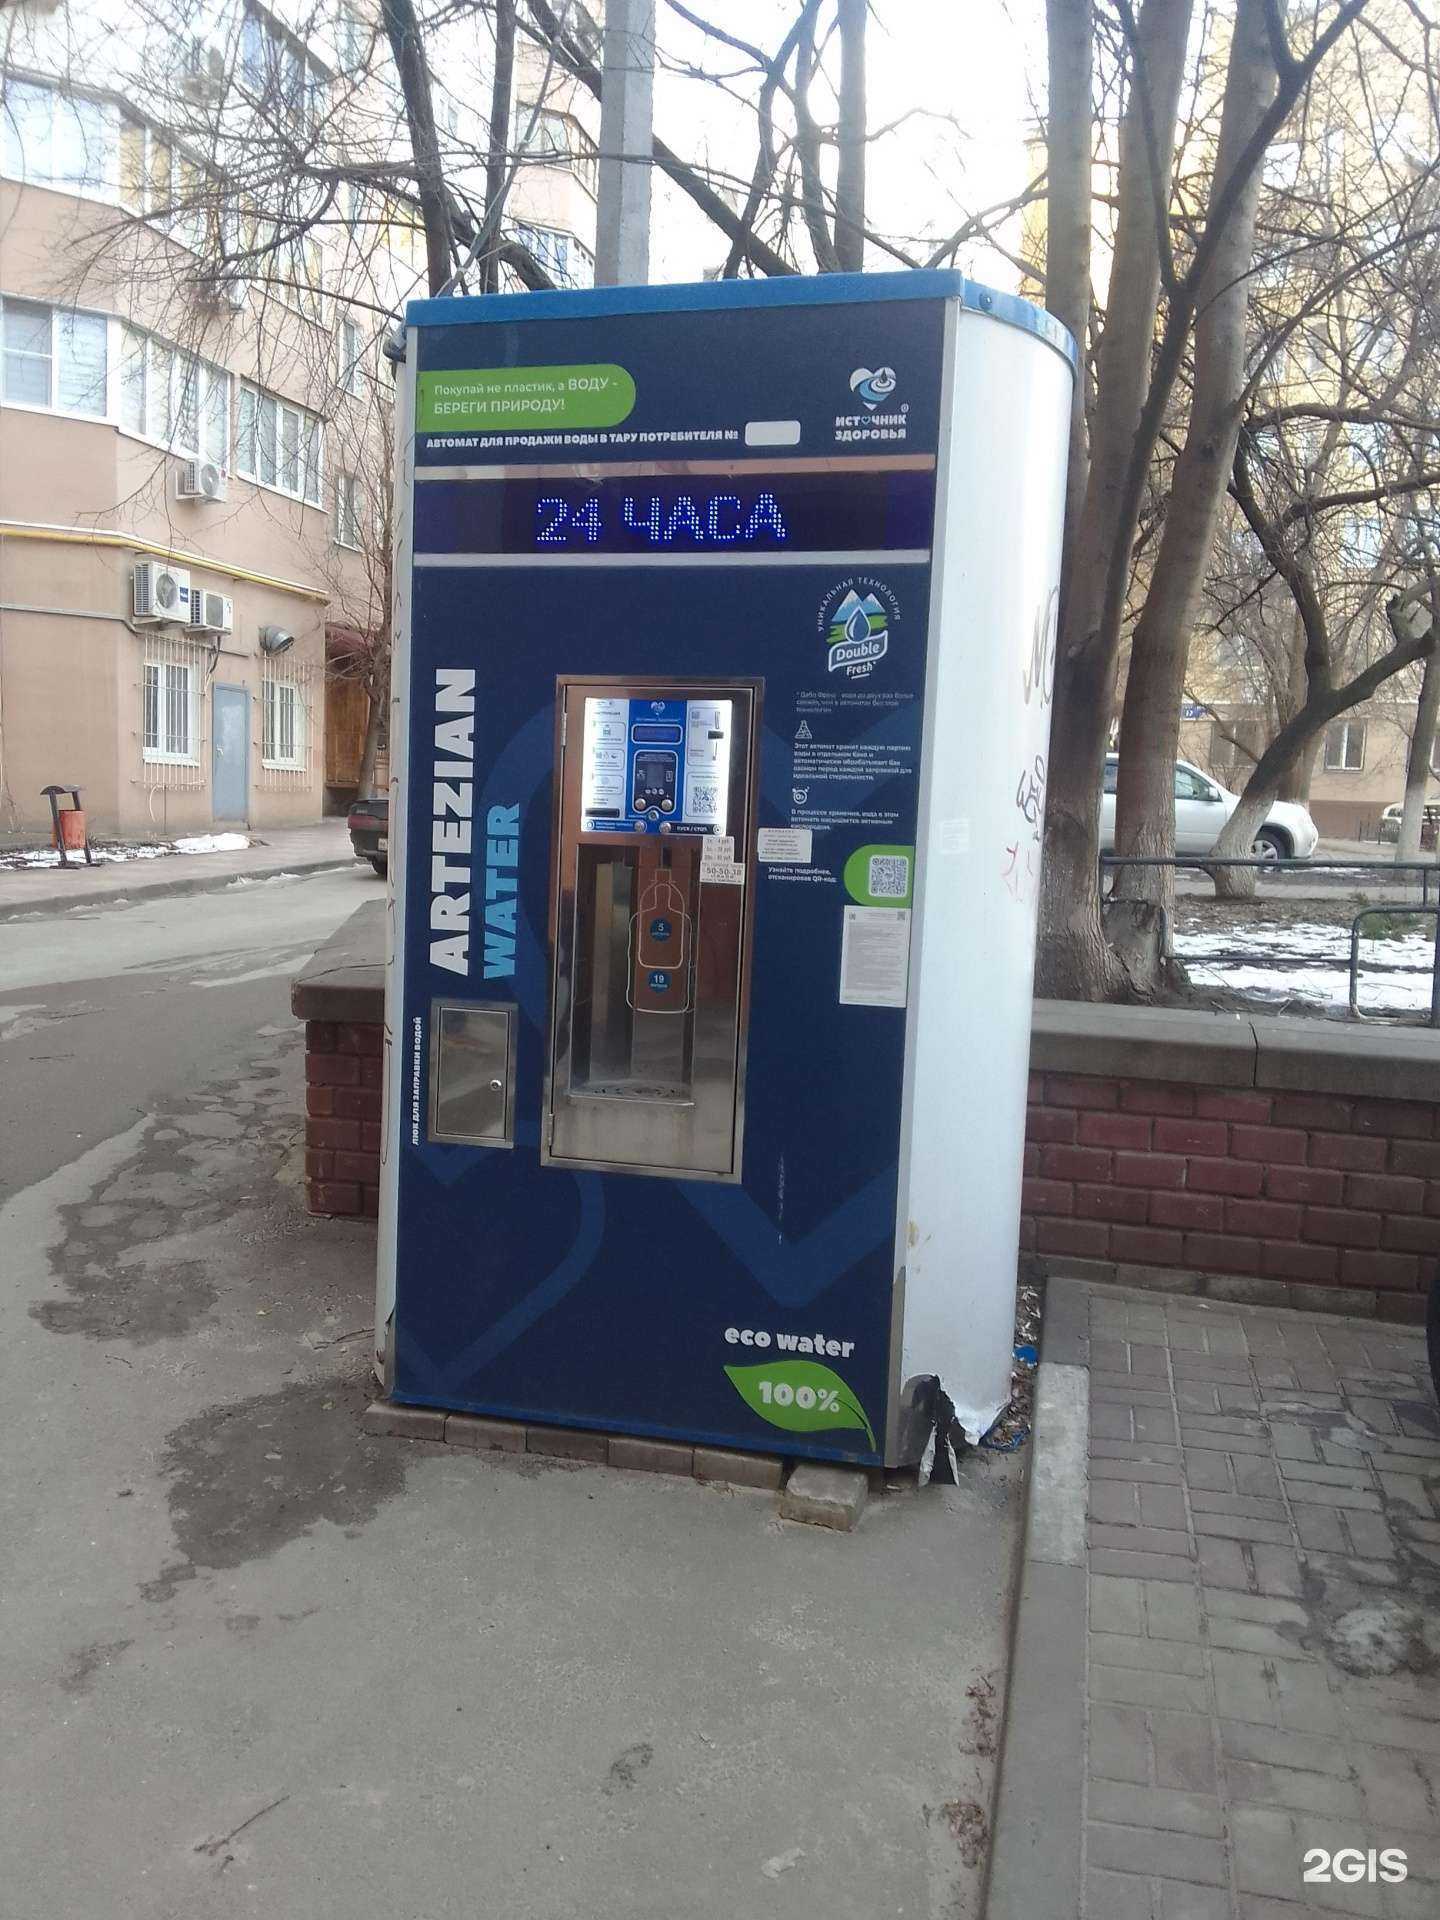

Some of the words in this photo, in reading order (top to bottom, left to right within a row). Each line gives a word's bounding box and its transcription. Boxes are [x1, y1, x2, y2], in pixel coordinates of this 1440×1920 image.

[434, 383, 485, 398] Покупай
[487, 384, 501, 393] не
[504, 382, 555, 395] пластик,
[557, 383, 565, 391] а
[568, 377, 609, 392] ВОДУ
[434, 401, 487, 415] БЕРЕГИ
[490, 398, 566, 413] ПРИРОДУ!
[426, 437, 480, 448] АВТОМАТ
[480, 436, 504, 448] ДЛЯ
[505, 435, 564, 447] ПРОДАЖИ
[564, 434, 598, 445] ВОДЫ
[600, 434, 608, 443] В
[609, 432, 638, 444] ТАРУ
[639, 430, 723, 442] ПОТРЕБИТЕЛЯ
[724, 429, 739, 440] №
[834, 428, 907, 442] ЗДОРОВЬЯ
[536, 497, 601, 541] 24
[622, 493, 786, 540] ЧАСА
[817, 578, 854, 632] УНИКАЛЬНАЯ
[857, 577, 901, 621] ТЕХНОЛОГИЯ
[836, 642, 881, 661] Double
[428, 668, 477, 977] ARTEZIAN
[483, 802, 521, 979] WATER
[657, 921, 664, 932] 5
[653, 974, 665, 984] 19
[412, 1016, 422, 1051] ВОДОЙ
[413, 1051, 421, 1101] ЗАПРАВКИ
[412, 1101, 420, 1122] ДЛЯ
[412, 1122, 420, 1146] ЛЮК
[724, 1327, 772, 1348] eco
[776, 1333, 856, 1358] water
[758, 1380, 840, 1413] 100%
